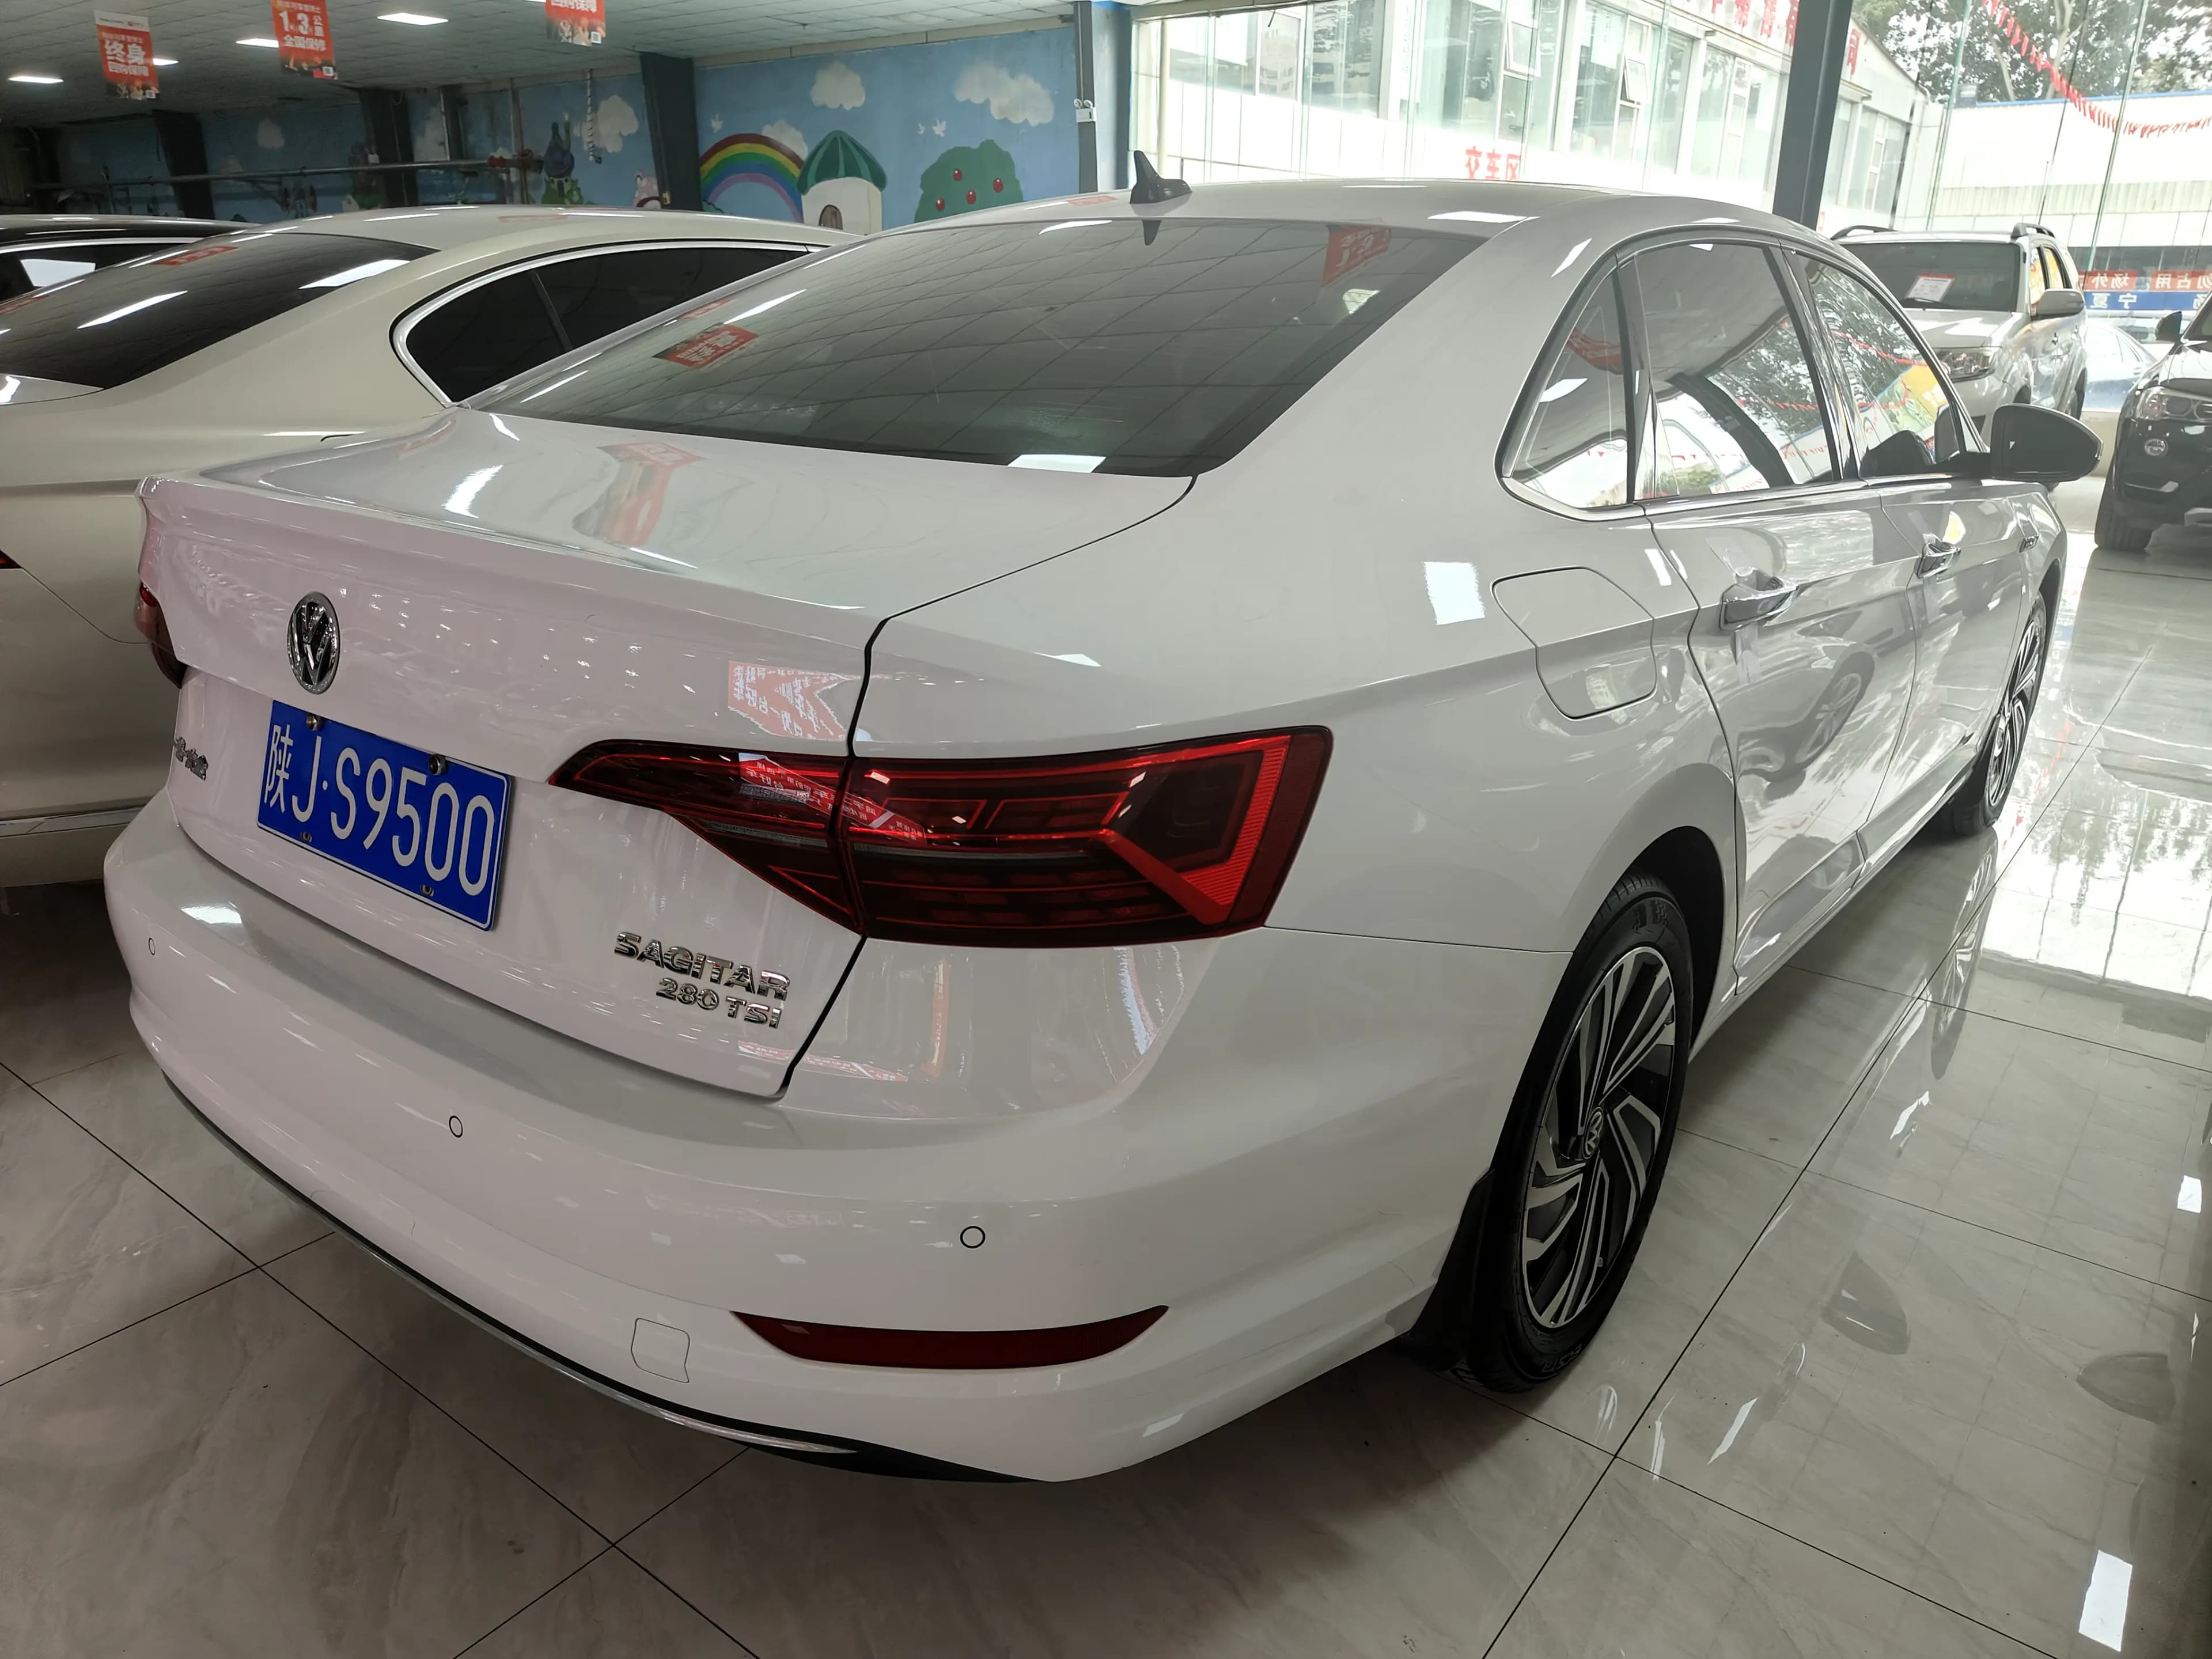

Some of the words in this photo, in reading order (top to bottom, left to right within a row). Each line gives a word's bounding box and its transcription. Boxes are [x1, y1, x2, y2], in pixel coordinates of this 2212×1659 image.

[105, 39, 146, 65] 终身
[1465, 146, 1521, 180] 交车区
[264, 724, 495, 896] 陕J·S9500
[614, 931, 790, 1001] SAGITAR
[656, 977, 719, 1010] 280
[726, 995, 782, 1029] TSI
